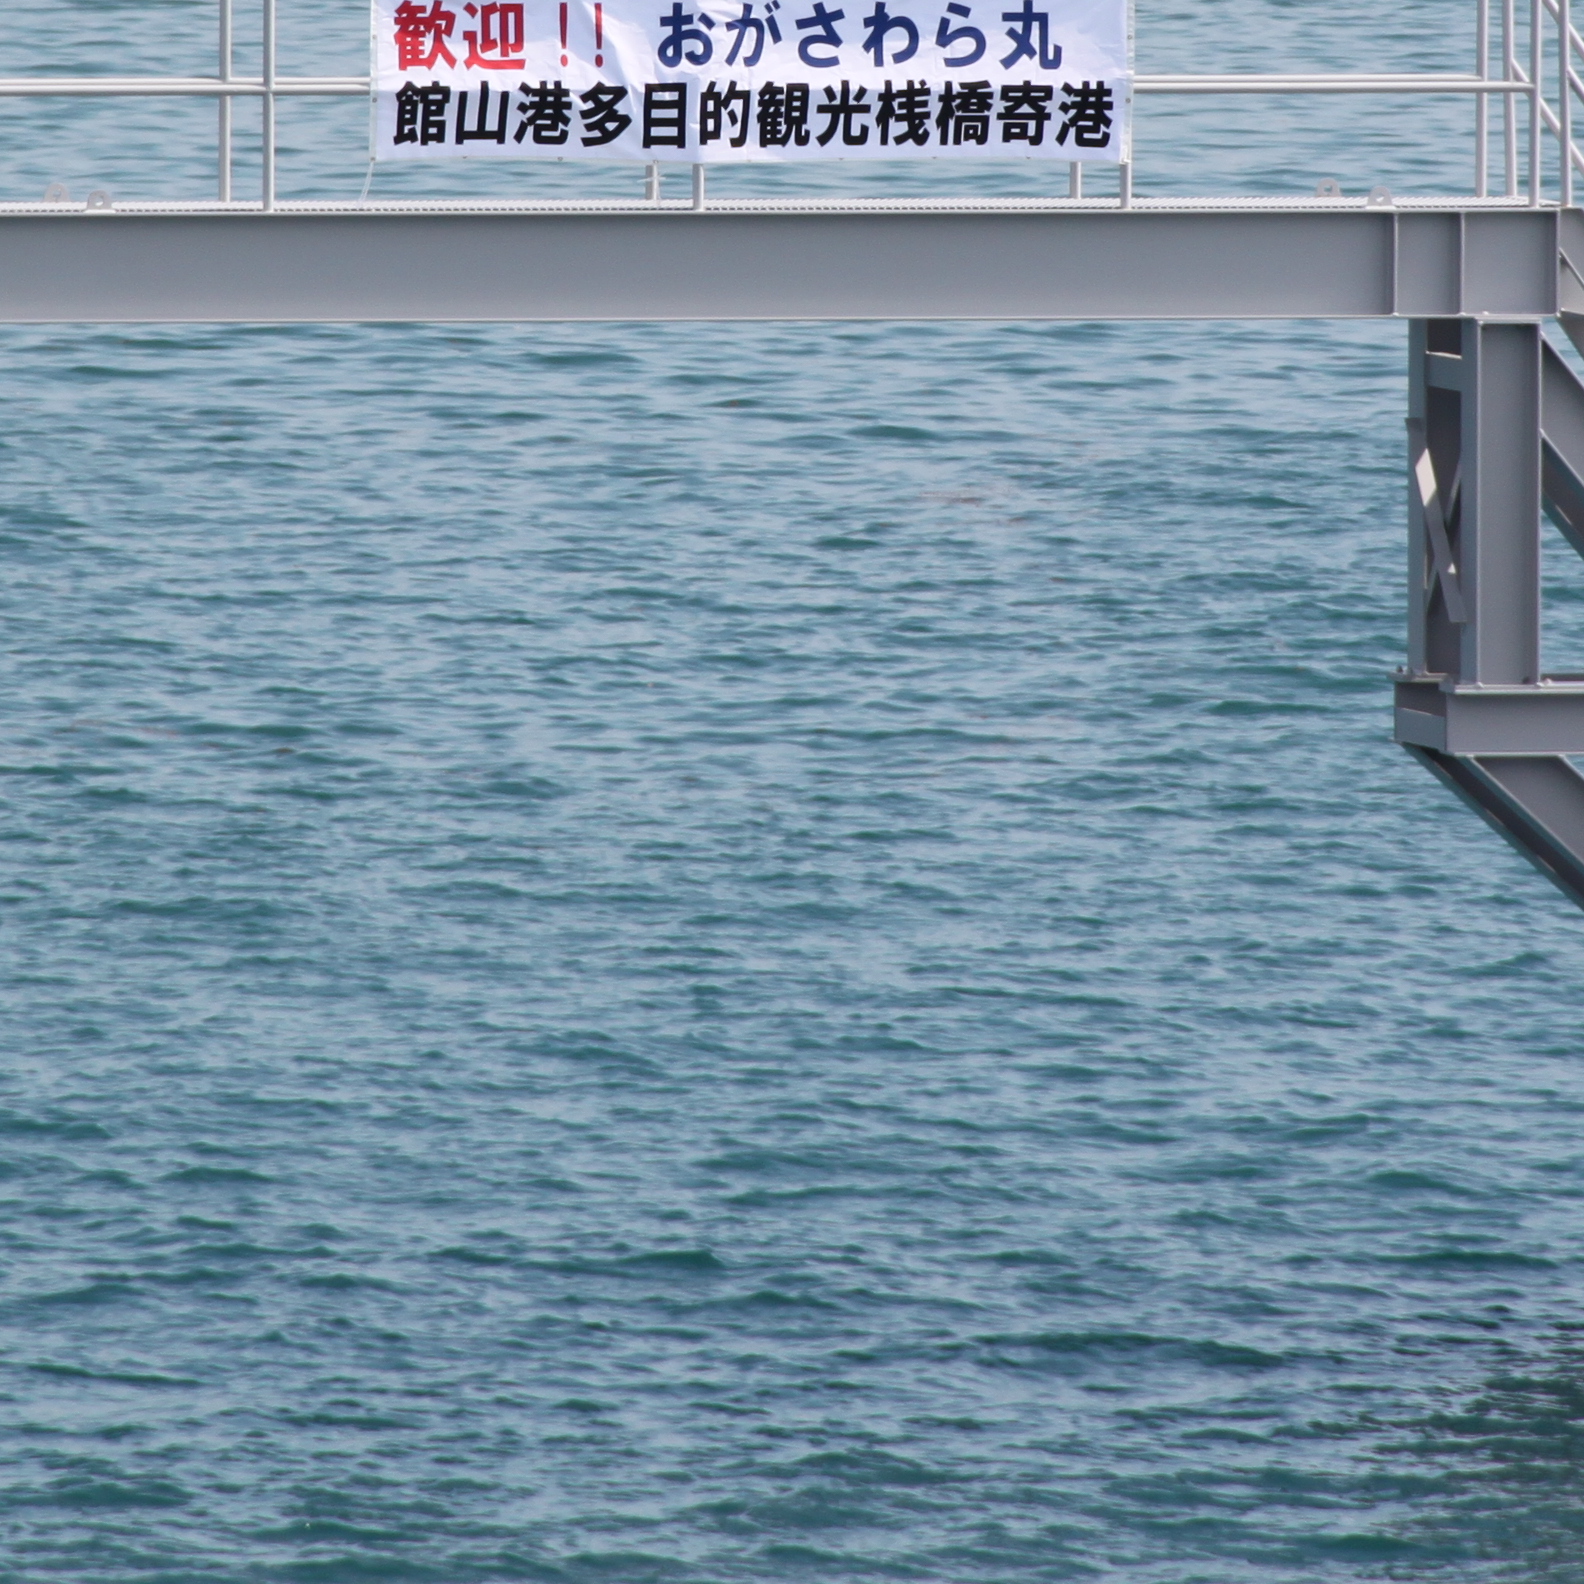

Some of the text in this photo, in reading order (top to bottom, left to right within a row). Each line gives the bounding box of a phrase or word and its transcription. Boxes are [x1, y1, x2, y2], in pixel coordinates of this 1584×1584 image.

[657, 0, 1063, 69] おがさわら丸
[392, 80, 1114, 151] 館山港多目的観光桟橋寄港
